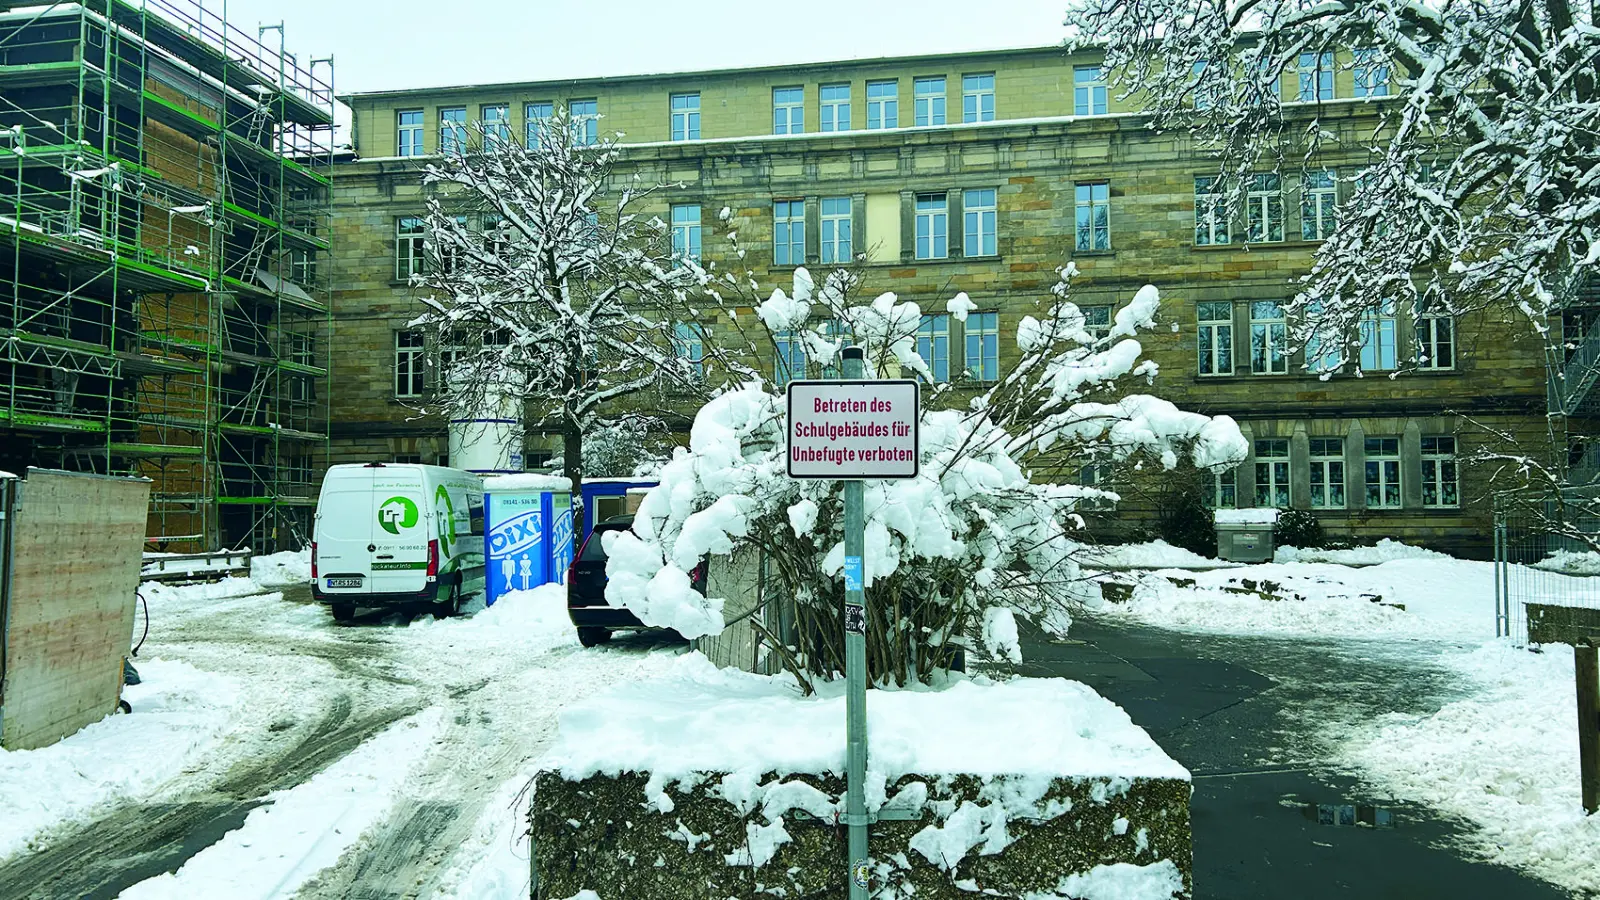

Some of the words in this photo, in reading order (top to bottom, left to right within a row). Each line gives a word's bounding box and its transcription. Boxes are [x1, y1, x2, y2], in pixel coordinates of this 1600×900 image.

[814, 398, 866, 412] Betreten
[870, 397, 891, 412] des
[795, 421, 889, 441] Schulgebäudes
[891, 421, 911, 437] für
[793, 446, 855, 465] Unbefugte
[858, 446, 912, 461] verboten
